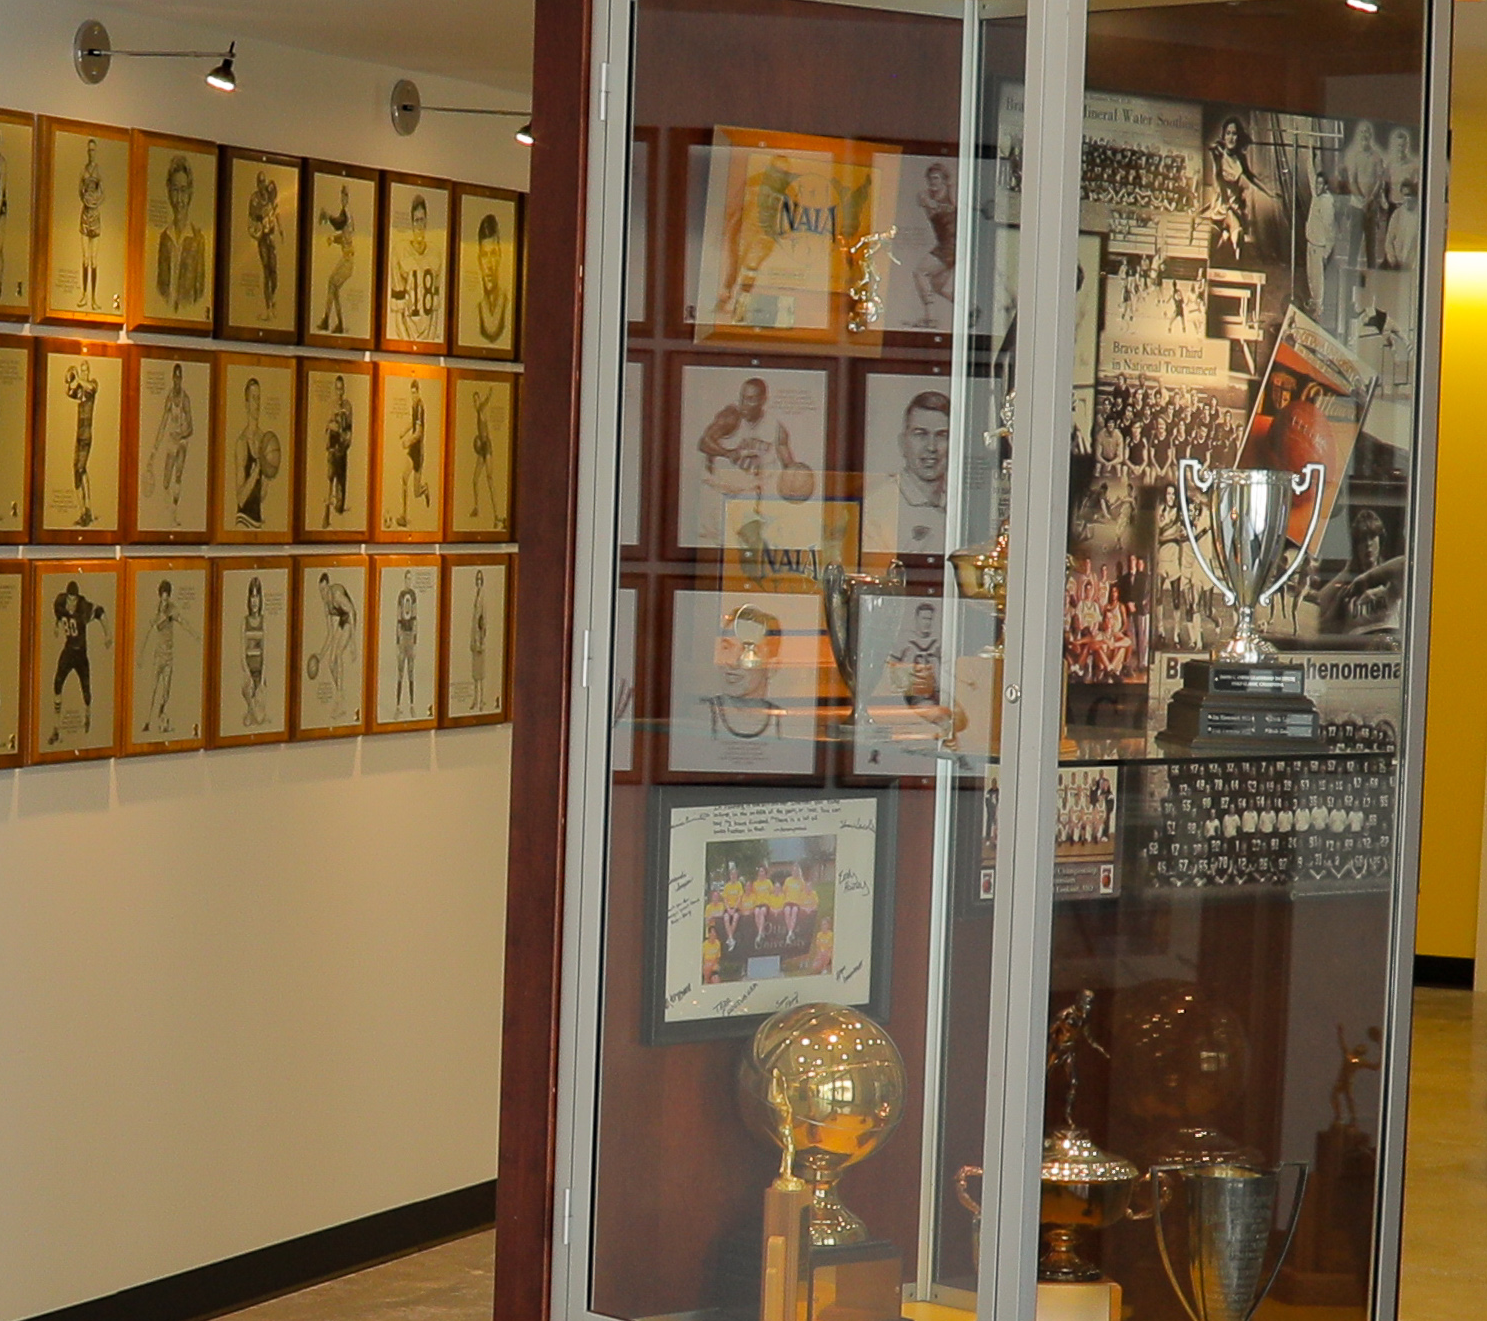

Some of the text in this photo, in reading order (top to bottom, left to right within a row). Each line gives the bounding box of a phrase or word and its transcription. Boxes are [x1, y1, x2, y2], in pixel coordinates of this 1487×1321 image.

[1122, 109, 1152, 126] Water
[778, 195, 839, 242] NAIA
[411, 269, 434, 317] 18
[1112, 341, 1203, 359] Brave Kickers Third
[1111, 358, 1217, 377] in National Tournament
